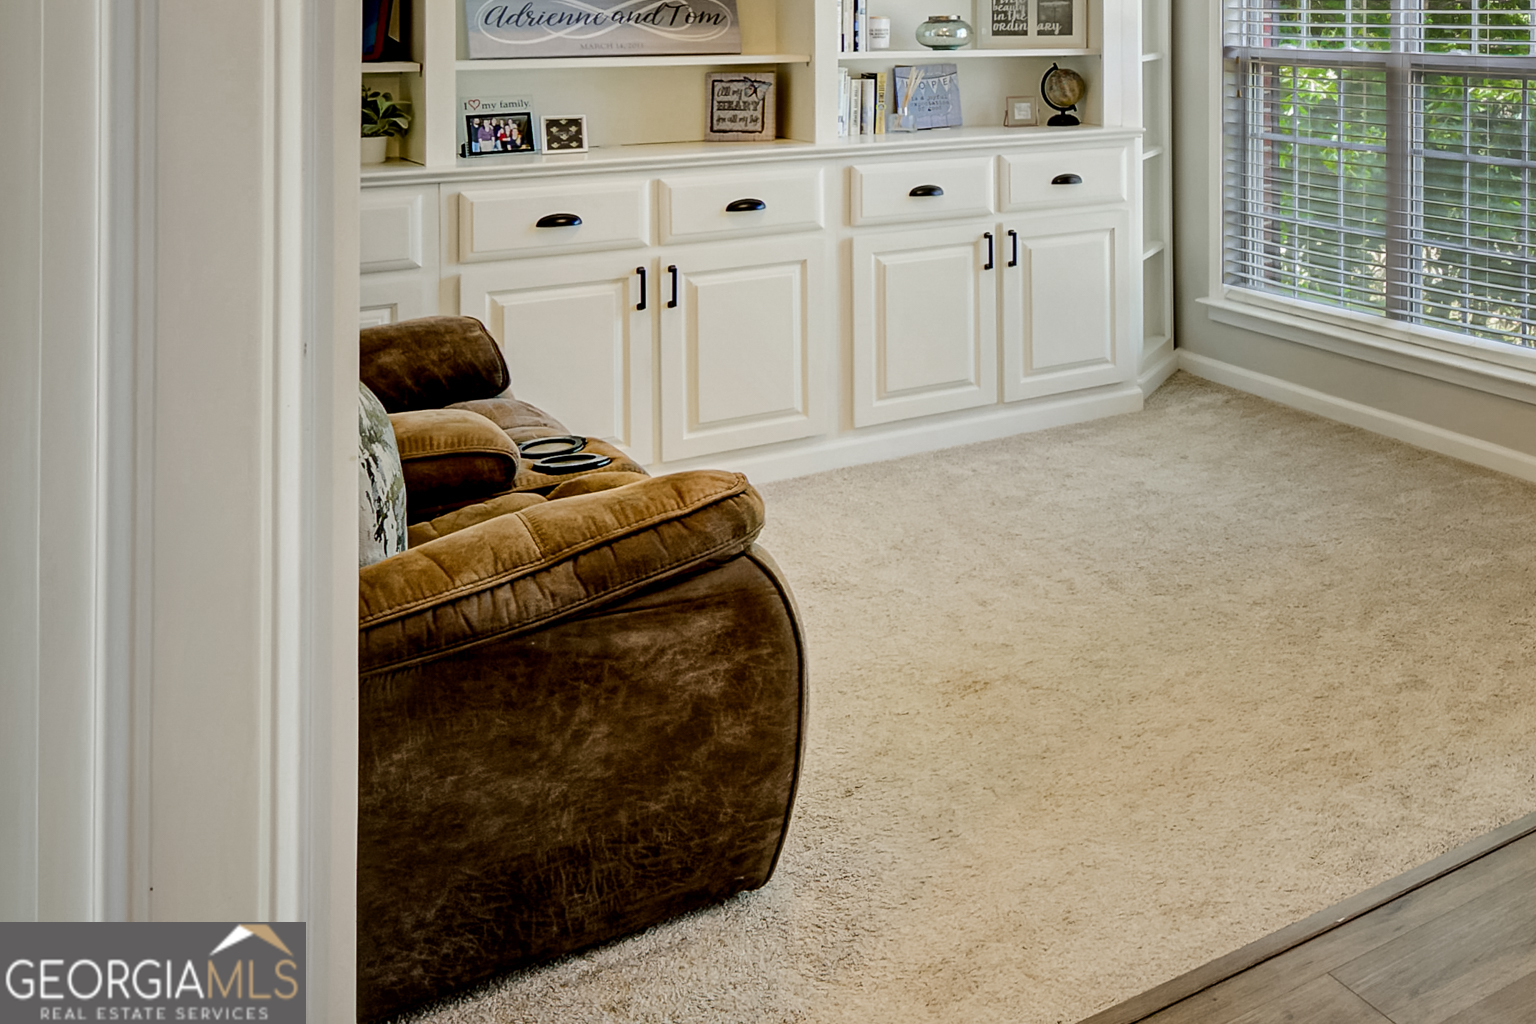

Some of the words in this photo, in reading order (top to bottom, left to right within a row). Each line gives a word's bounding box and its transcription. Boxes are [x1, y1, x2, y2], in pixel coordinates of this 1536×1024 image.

[484, 2, 609, 27] Adrienne
[611, 2, 667, 25] and
[665, 4, 726, 26] Tom
[994, 11, 1007, 21] in
[1007, 9, 1027, 21] the
[481, 103, 496, 111] my
